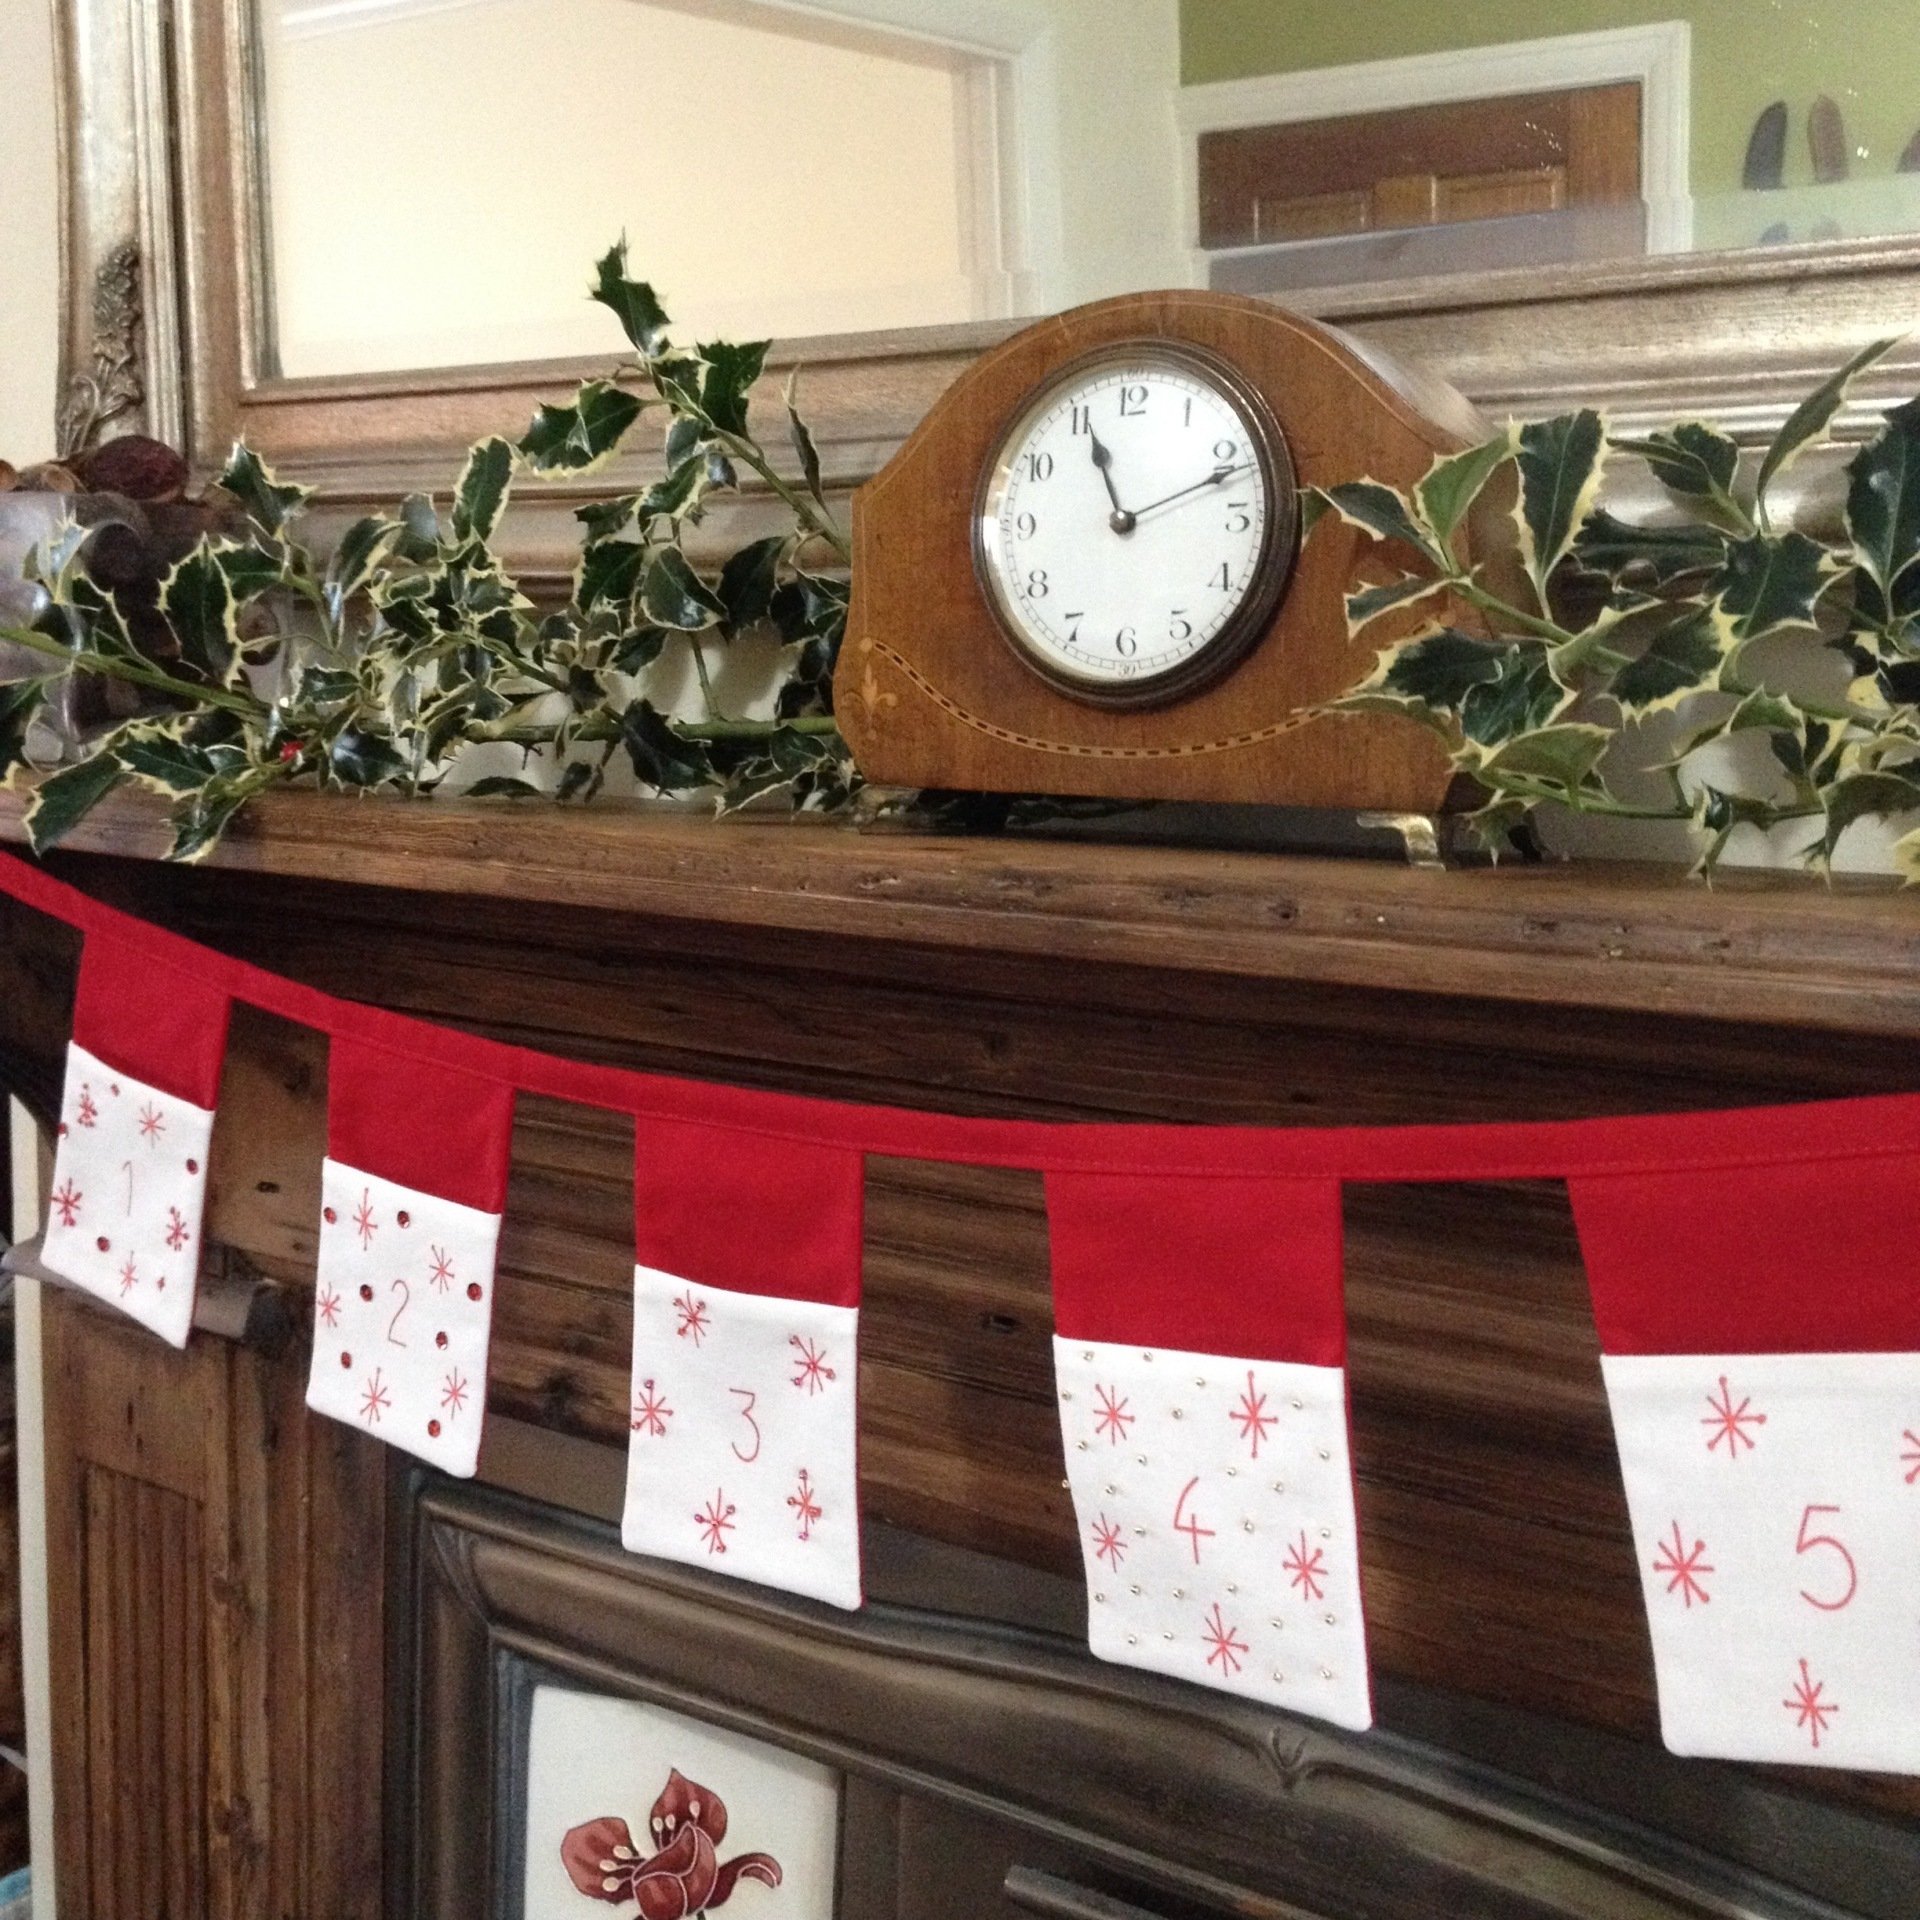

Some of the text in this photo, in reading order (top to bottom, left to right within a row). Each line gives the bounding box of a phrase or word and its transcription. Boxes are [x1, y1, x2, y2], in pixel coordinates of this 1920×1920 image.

[1120, 386, 1149, 417] 12
[1183, 397, 1193, 428] 1
[1072, 405, 1090, 435] 11
[1029, 452, 1054, 483] 10
[1213, 439, 1238, 474] 2
[1017, 511, 1036, 541] 9
[1225, 502, 1250, 534] 3
[1026, 569, 1049, 599] 8
[1208, 562, 1234, 592] 4
[1064, 611, 1085, 643] 7
[1169, 609, 1193, 641] 5
[1115, 626, 1137, 658] 6
[121, 1159, 134, 1217] 1
[387, 1279, 408, 1347] 2
[729, 1387, 761, 1464] 3
[1173, 1476, 1216, 1566] 4
[1795, 1503, 1858, 1612] 5
